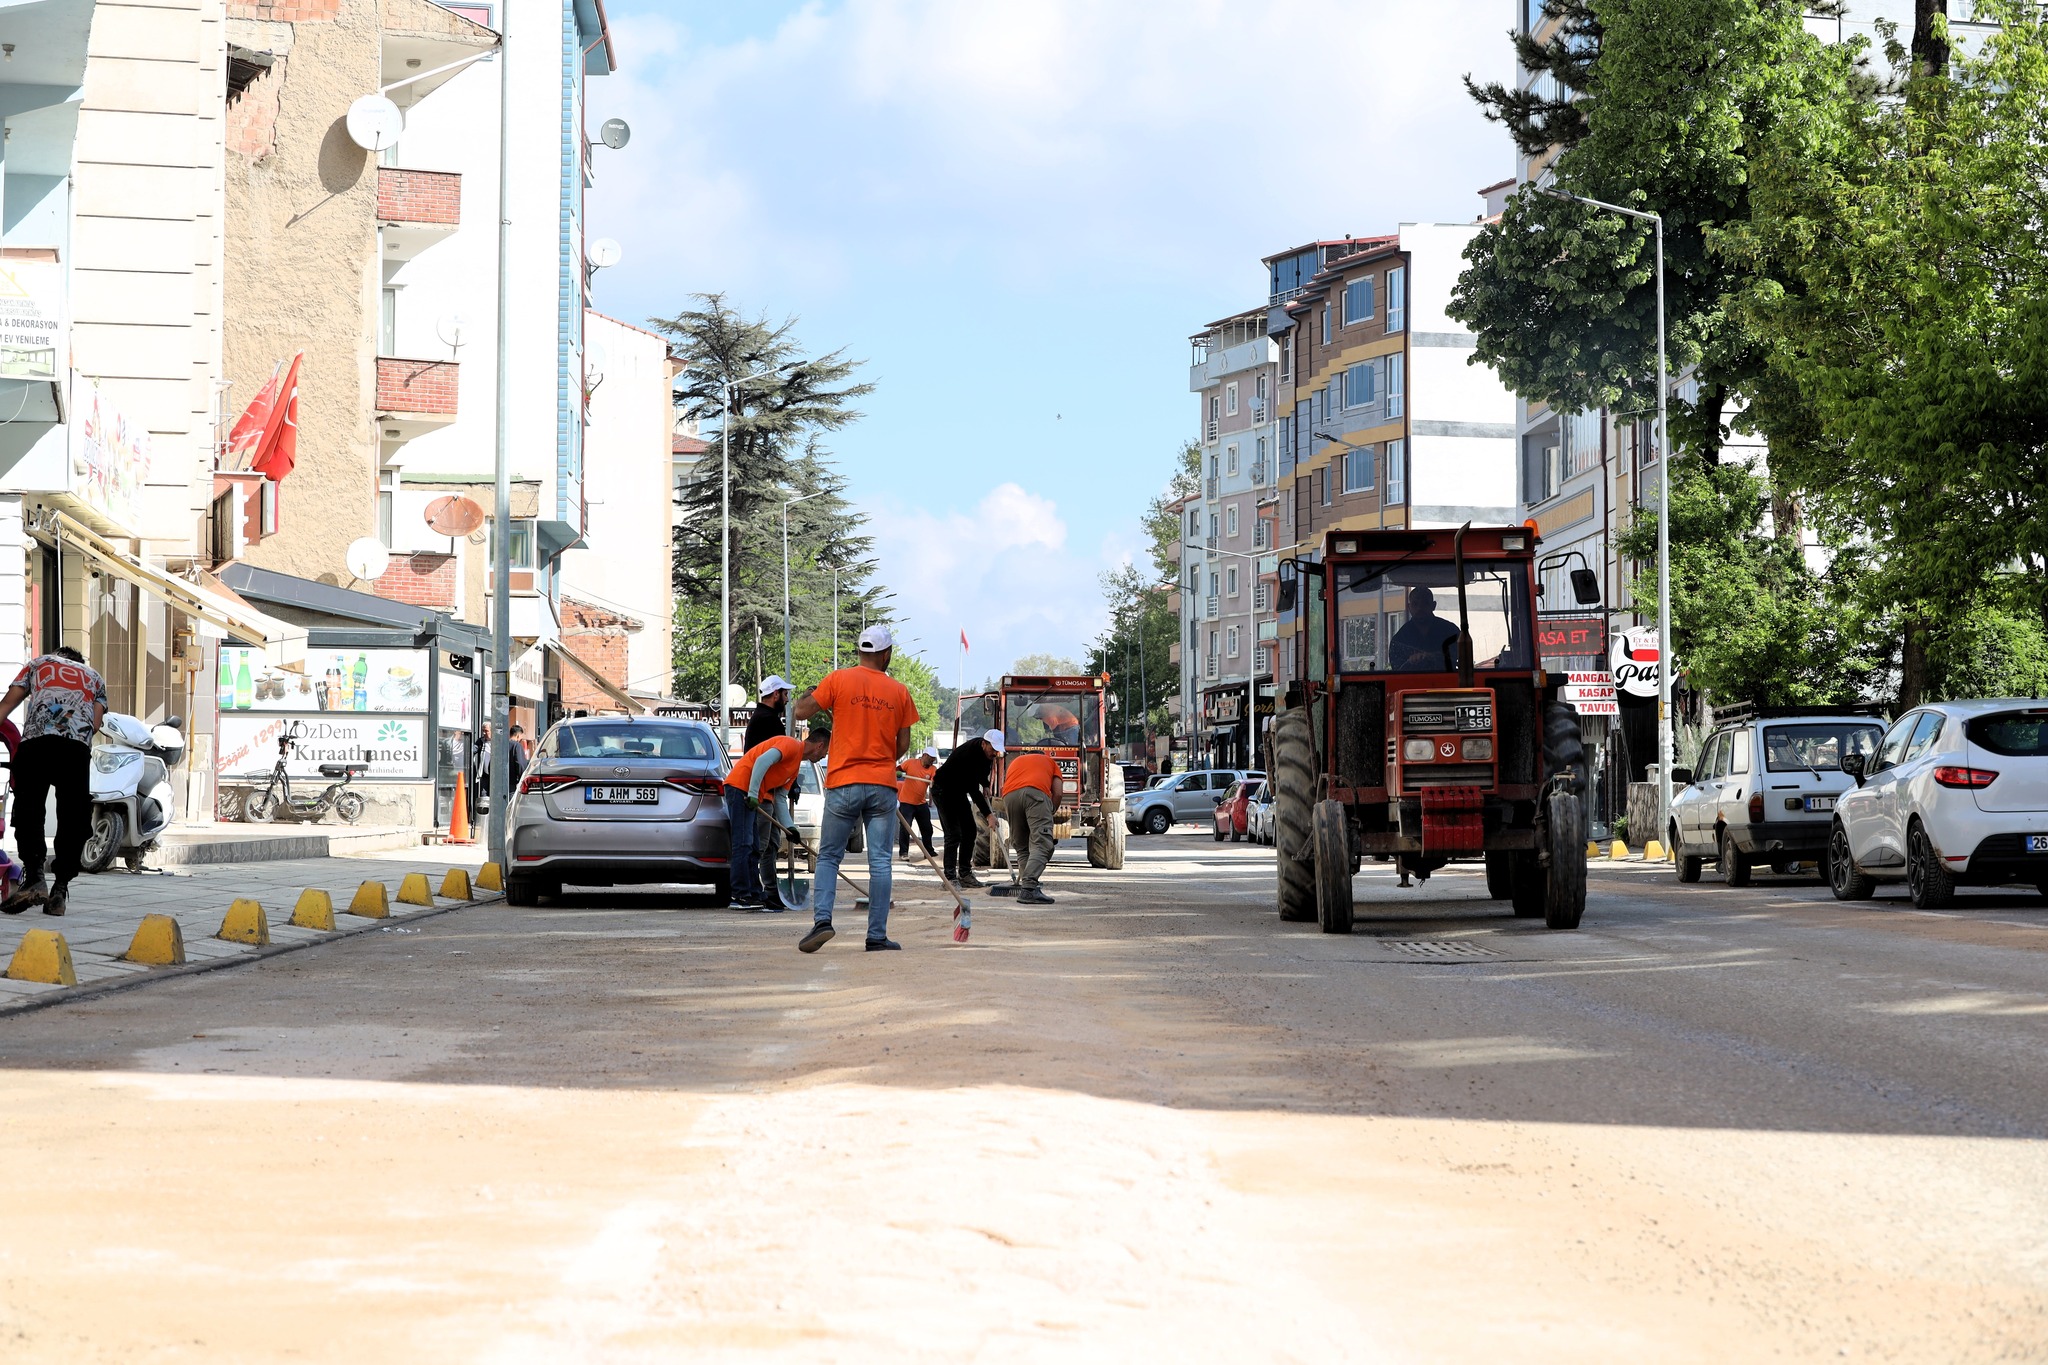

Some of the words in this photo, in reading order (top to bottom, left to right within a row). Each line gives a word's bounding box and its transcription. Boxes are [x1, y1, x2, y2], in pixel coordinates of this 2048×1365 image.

[12, 319, 58, 330] DEKORASYON
[5, 334, 13, 343] EV
[16, 333, 50, 345] YENİLEME
[1539, 631, 1566, 646] ASA
[1571, 629, 1589, 644] ET
[1568, 673, 1611, 683] MANGAL
[1579, 687, 1614, 697] KASAP
[1244, 702, 1275, 716] Çorb
[1580, 703, 1616, 713] TAVUK
[658, 710, 700, 720] KAHVALTI
[1469, 717, 1491, 728] 558
[254, 719, 282, 748] 1299
[294, 720, 358, 739] ÖzDem
[294, 744, 418, 761] Kıraathanesi
[364, 765, 404, 774] arihinden
[593, 788, 603, 799] 16
[609, 788, 630, 799] AHM
[636, 788, 656, 800] 569
[1812, 798, 1821, 808] 11
[2033, 836, 2048, 849] 26
